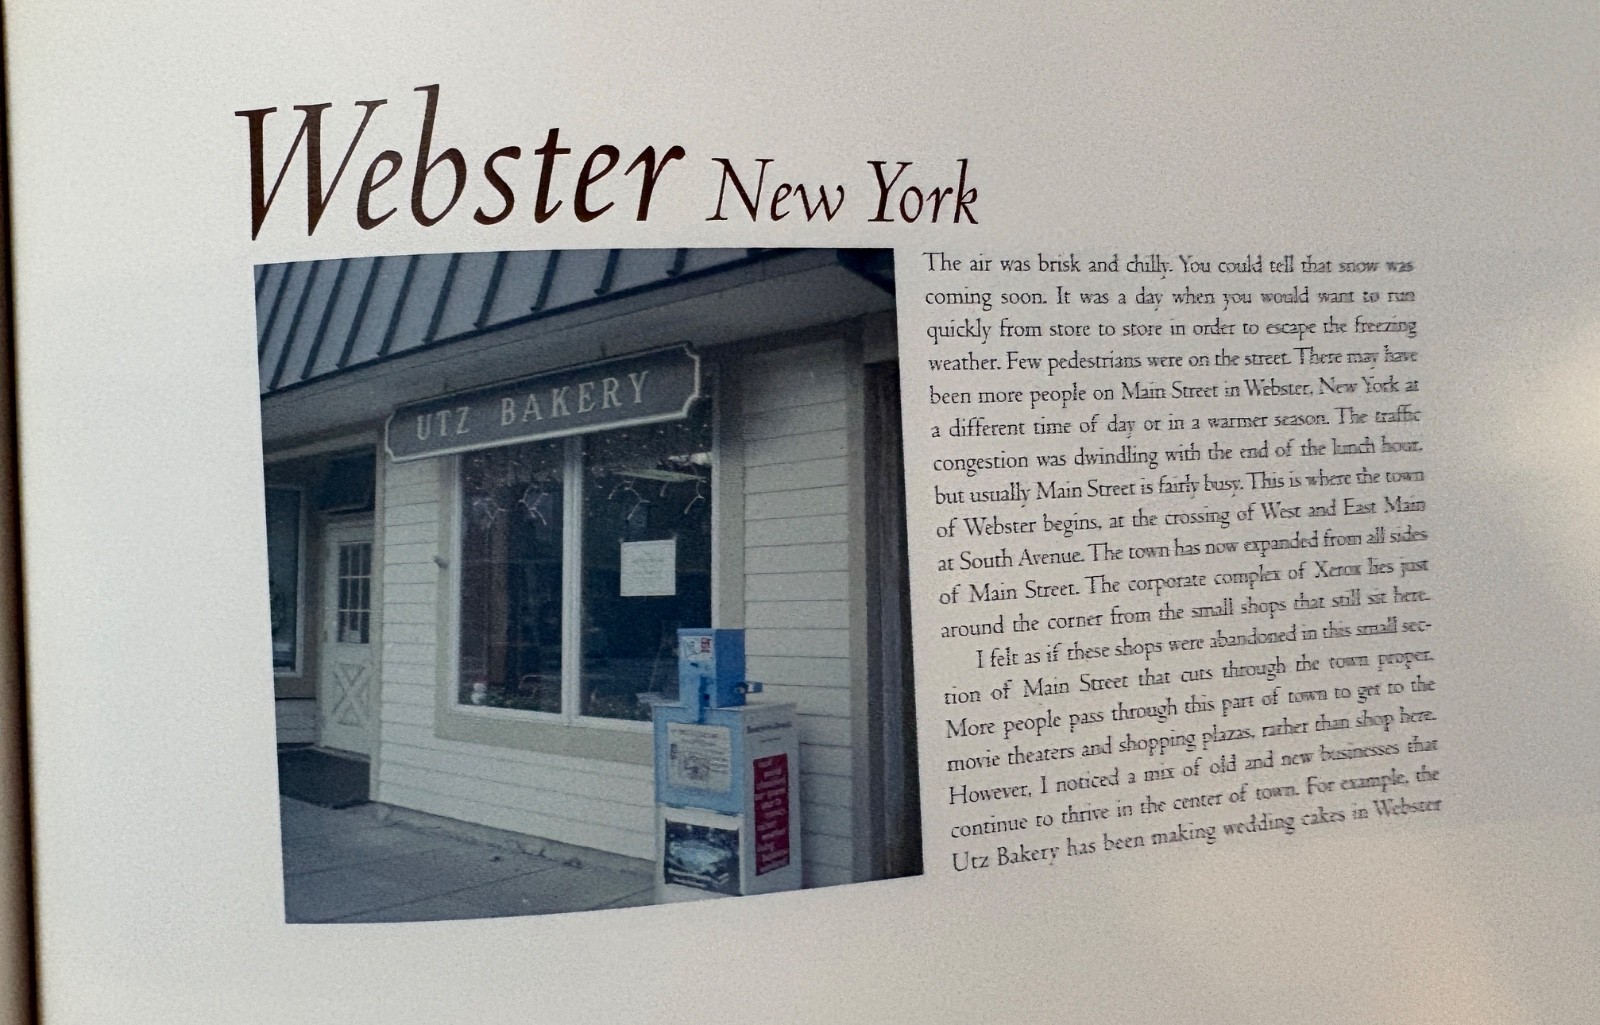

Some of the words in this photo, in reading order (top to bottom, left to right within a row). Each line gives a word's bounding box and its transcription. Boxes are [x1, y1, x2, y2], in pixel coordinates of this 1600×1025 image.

[235, 83, 686, 241] Webster
[705, 157, 847, 223] New
[867, 157, 981, 225] York
[921, 251, 962, 271] The
[969, 254, 992, 271] air
[999, 259, 1031, 272] was
[1038, 252, 1082, 272] brisk
[1087, 253, 1120, 272] and
[1125, 253, 1173, 280] chilly.
[1177, 254, 1211, 273] You
[1217, 253, 1263, 273] could
[1269, 253, 1294, 273] tell
[1300, 254, 1333, 273] that
[924, 285, 993, 312] coming
[1000, 292, 1047, 305] soon.
[1056, 285, 1071, 304] It
[1079, 292, 1109, 304] was
[1117, 292, 1127, 305] a
[1135, 285, 1163, 311] day
[1171, 285, 1216, 304] when
[1221, 292, 1252, 311] you
[1259, 285, 1310, 304] would
[926, 317, 992, 345] quickly
[998, 317, 1043, 337] from
[1048, 323, 1091, 337] store
[1097, 323, 1116, 336] to
[1121, 322, 1163, 336] store
[1169, 318, 1186, 336] in
[1192, 316, 1236, 335] order
[1242, 322, 1259, 335] to
[1322, 314, 1347, 333] the
[927, 350, 1002, 371] weather.
[1006, 350, 1042, 370] Few
[1047, 349, 1142, 376] pedestrians
[1146, 355, 1183, 367] were
[1187, 355, 1210, 367] on
[1213, 347, 1240, 366] the
[416, 406, 470, 441] UTZ
[501, 370, 649, 426] BAKERY
[929, 384, 971, 404] been
[977, 390, 1024, 403] more
[1029, 381, 1086, 409] people
[1092, 388, 1114, 400] on
[1121, 381, 1167, 400] Main
[1170, 380, 1219, 399] Street
[1224, 380, 1240, 397] in
[1317, 376, 1358, 395] New
[1360, 374, 1400, 394] York
[930, 425, 941, 438] a
[948, 416, 1025, 437] different
[1032, 416, 1072, 435] time
[1078, 413, 1098, 433] of
[1106, 412, 1136, 439] day
[1143, 419, 1162, 431] or
[1167, 412, 1185, 430] in
[1190, 418, 1201, 429] a
[1334, 406, 1368, 425] The
[932, 451, 1029, 477] congestion
[1035, 454, 1067, 467] was
[1073, 444, 1159, 470] dwindling
[1164, 441, 1201, 462] with
[1207, 441, 1233, 460] the
[1274, 437, 1292, 457] of
[934, 484, 965, 505] but
[969, 481, 1031, 508] usually
[1035, 480, 1082, 500] Main
[1086, 478, 1136, 498] Street
[1139, 477, 1154, 495] is
[1245, 470, 1285, 490] This
[935, 516, 956, 538] of
[963, 514, 1037, 536] Webster
[1042, 512, 1102, 538] begins,
[1108, 515, 1125, 529] at
[1131, 507, 1158, 527] the
[1164, 505, 1231, 529] crossing
[1236, 501, 1255, 521] of
[937, 557, 954, 572] at
[959, 547, 1013, 570] South
[1087, 541, 1124, 562] The
[1128, 545, 1170, 559] town
[1174, 537, 1201, 556] has
[1204, 541, 1239, 554] now
[938, 583, 959, 605] of
[968, 582, 1018, 603] Main
[1024, 579, 1080, 599] Street.
[1084, 573, 1120, 594] The
[1127, 574, 1206, 597] corporate
[1287, 560, 1305, 580] of
[940, 613, 1004, 638] around
[1012, 612, 1040, 632] the
[1047, 614, 1104, 630] corner
[1109, 604, 1151, 625] from
[1157, 601, 1184, 621] the
[1190, 596, 1234, 618] small
[1240, 595, 1287, 619] shops
[976, 649, 984, 668] I
[989, 646, 1019, 668] felt
[1023, 651, 1041, 664] as
[1045, 642, 1059, 662] if
[1066, 640, 1110, 662] these
[1114, 636, 1163, 661] shops
[1167, 638, 1204, 651] were
[1209, 623, 1297, 648] abandoned
[943, 686, 981, 705] tion
[989, 678, 1011, 700] of
[1022, 677, 1070, 698] Main
[1078, 673, 1129, 693] Street
[1137, 666, 1171, 686] that
[1220, 655, 1287, 681] through
[1295, 653, 1320, 672] the
[945, 717, 996, 739] More
[1002, 708, 1061, 740] people
[1068, 710, 1104, 733] pass
[1110, 696, 1178, 724] through
[1184, 693, 1215, 714] this
[1221, 695, 1255, 717] part
[1260, 685, 1278, 706] of
[946, 749, 1000, 772] movie
[1007, 744, 1075, 765] theaters
[1081, 734, 1113, 757] and
[1118, 729, 1197, 757] shopping
[948, 784, 1032, 805] However,
[1040, 775, 1048, 795] I
[1055, 766, 1120, 793] noticed
[1127, 772, 1137, 784] a
[1180, 756, 1200, 777] of
[1208, 753, 1237, 774] old
[1244, 749, 1274, 770] and
[1280, 752, 1314, 766] new
[950, 815, 1028, 838] continue
[1035, 814, 1054, 827] to
[1061, 802, 1110, 824] thrive
[1116, 799, 1133, 817] in
[1139, 794, 1166, 814] the
[1172, 793, 1223, 810] center
[1227, 782, 1247, 803] of
[1305, 775, 1335, 796] For
[952, 850, 990, 872] Utz
[997, 843, 1060, 866] Bakery
[1066, 836, 1096, 856] has
[1103, 832, 1145, 851] been
[1150, 823, 1217, 845] making
